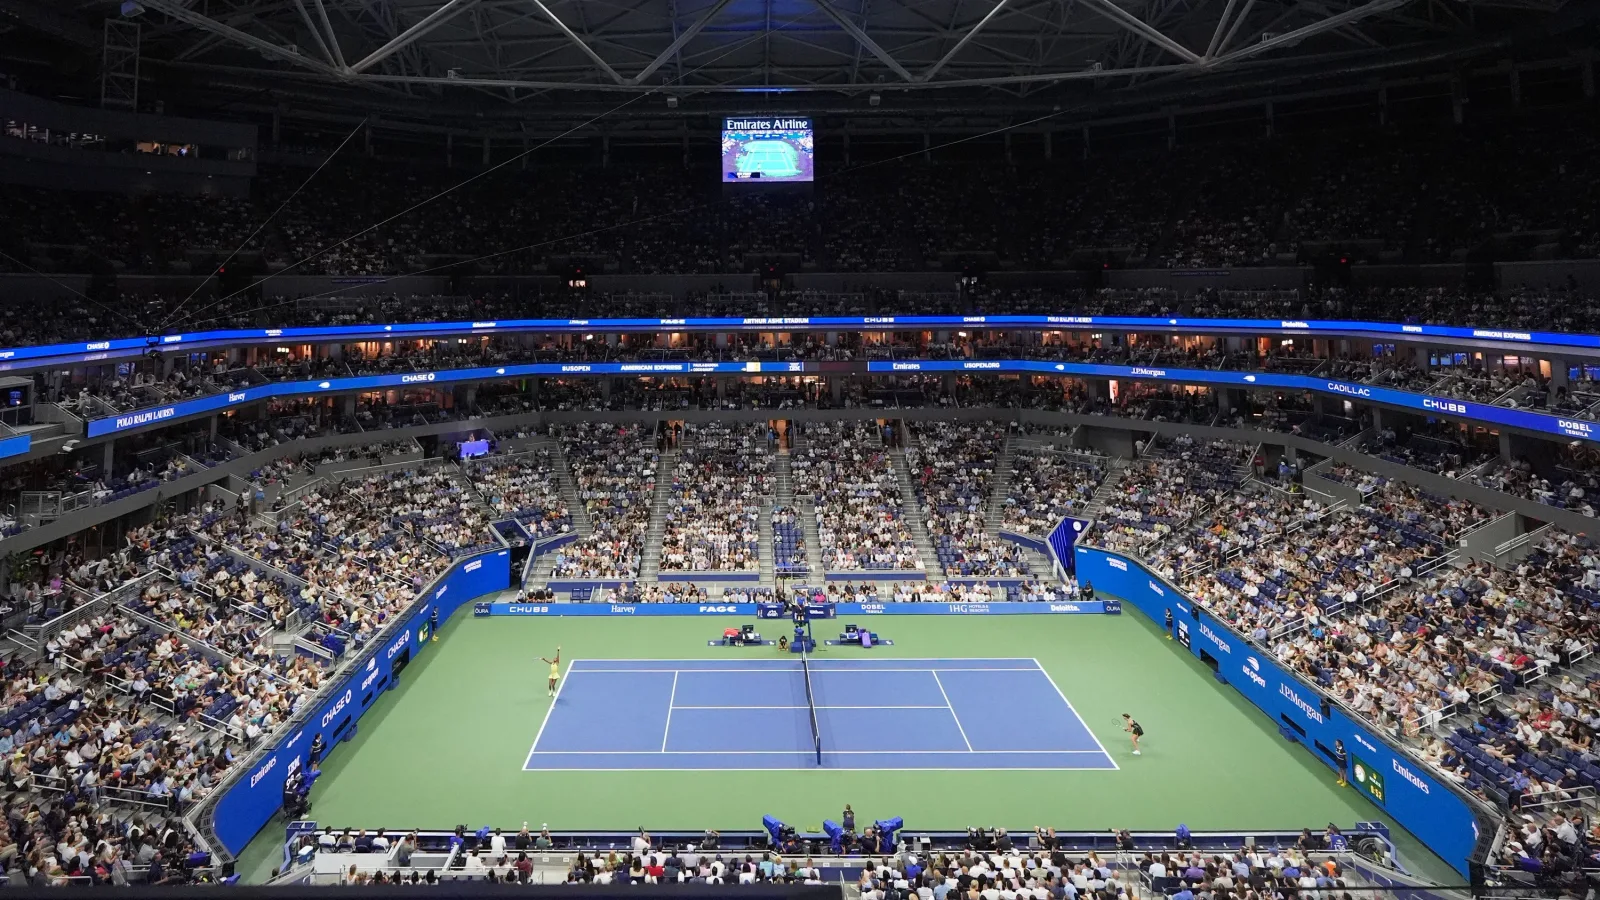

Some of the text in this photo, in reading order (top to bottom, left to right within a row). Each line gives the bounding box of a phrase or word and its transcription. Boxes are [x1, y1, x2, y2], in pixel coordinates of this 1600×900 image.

[727, 119, 808, 130] Emirates Airline
[1474, 330, 1531, 340] AMERICAN EXPRESS
[402, 374, 428, 382] CHASE
[1131, 368, 1166, 377] J.P.Morgan
[229, 392, 246, 402] Harvey
[1328, 382, 1370, 397] CADILLAC
[1423, 398, 1466, 414] CHUBB
[116, 408, 174, 428] POLO RALPH LAUREN
[1558, 420, 1593, 434] DOBEL
[1564, 428, 1588, 438] TEQUILA
[611, 604, 636, 614] Harvey
[949, 604, 968, 612] IHG
[1050, 604, 1080, 612] Deloitte.
[1199, 623, 1231, 654] J.P.Morgan
[388, 636, 405, 659] CHASE
[1242, 665, 1266, 688] us open
[1279, 682, 1323, 724] J.P.Morgan
[322, 697, 346, 728] CHASE
[250, 756, 276, 788] Emirates
[288, 755, 300, 778] IBM
[1392, 758, 1430, 795] Emirates
